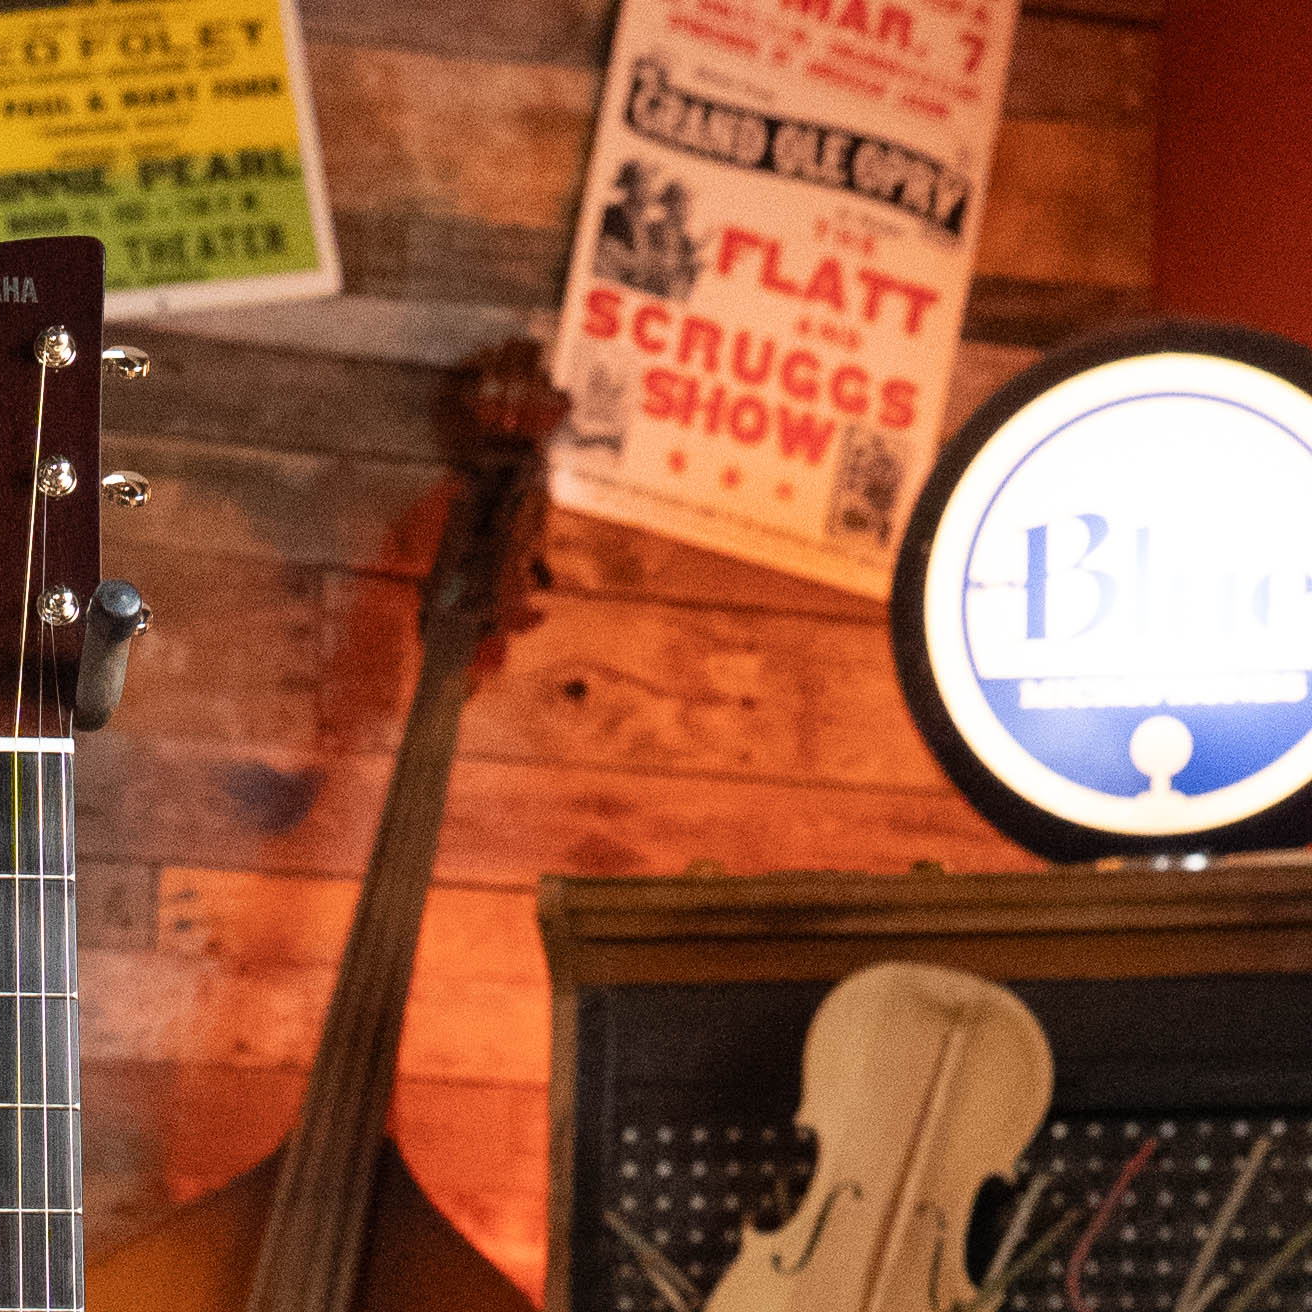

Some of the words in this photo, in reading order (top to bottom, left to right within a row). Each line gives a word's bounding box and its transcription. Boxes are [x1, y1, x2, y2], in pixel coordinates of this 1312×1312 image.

[959, 33, 986, 73] 7
[716, 226, 942, 337] FLATT
[586, 288, 919, 430] SCRUGGS
[640, 366, 837, 467] SHOW
